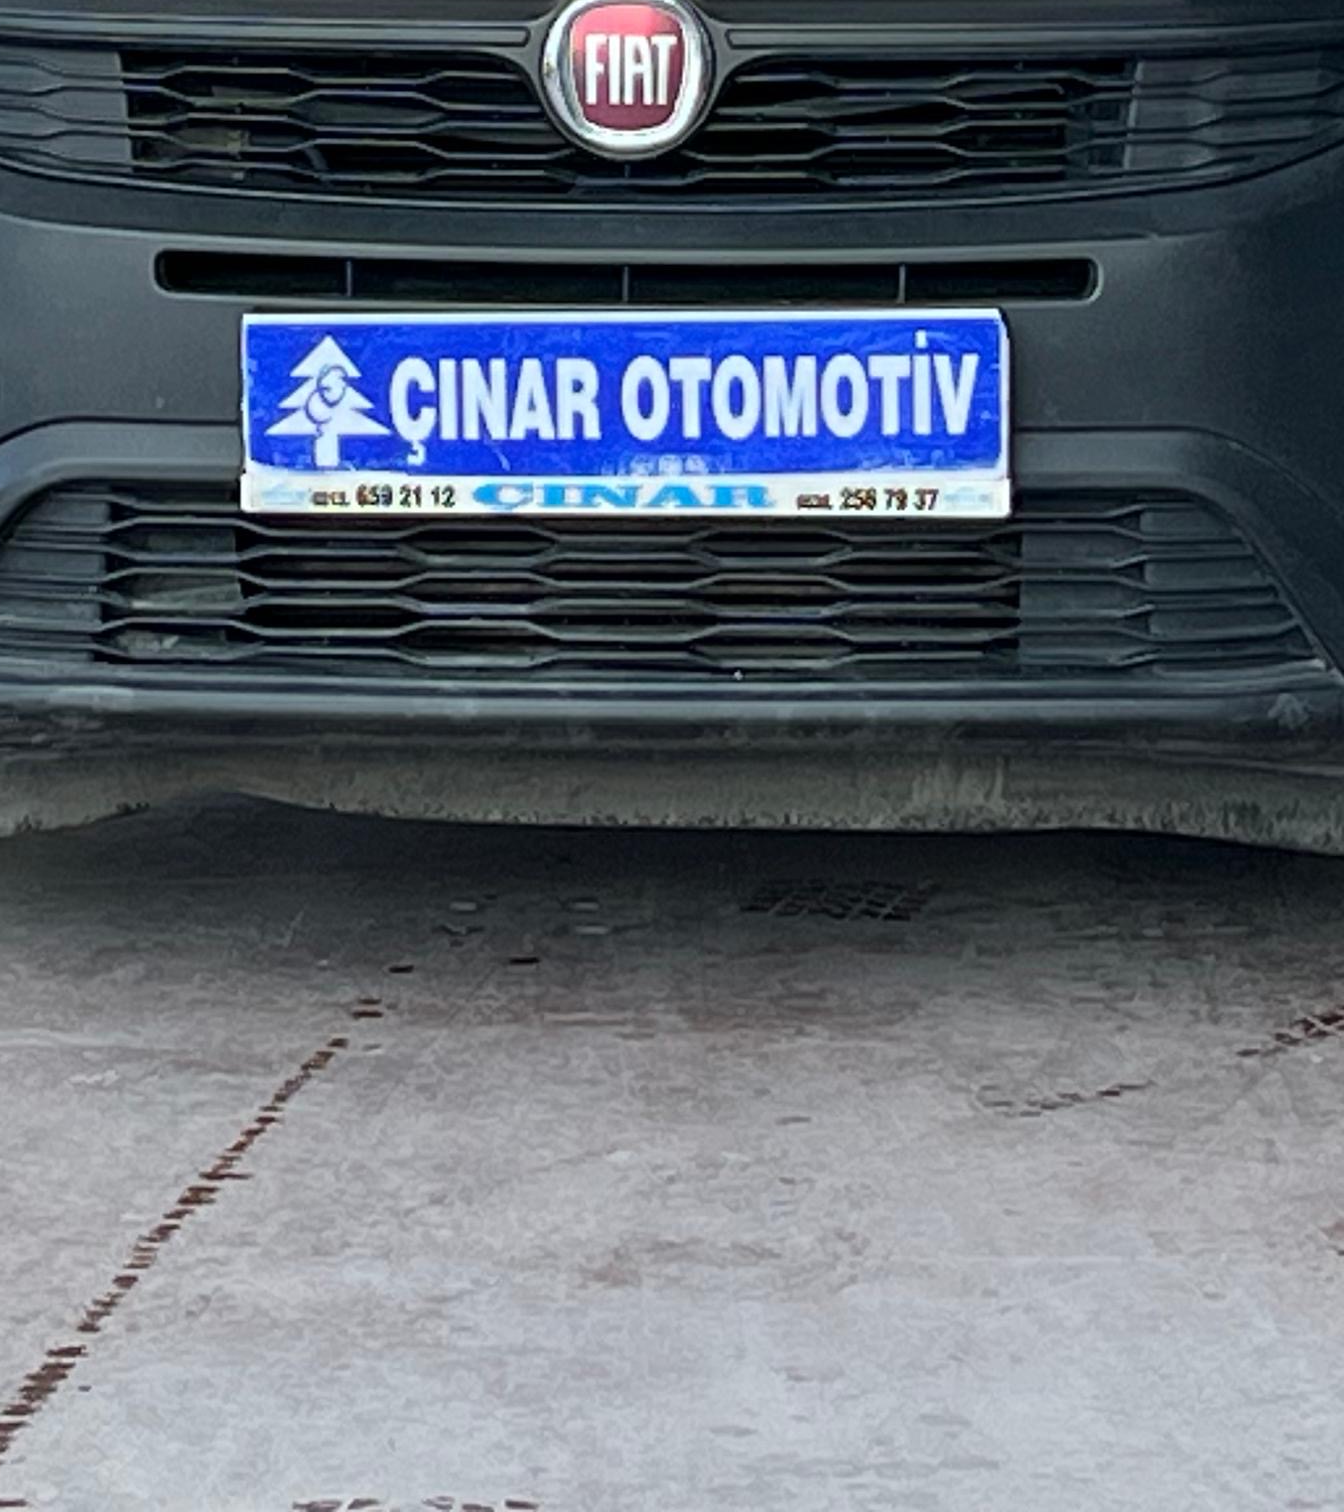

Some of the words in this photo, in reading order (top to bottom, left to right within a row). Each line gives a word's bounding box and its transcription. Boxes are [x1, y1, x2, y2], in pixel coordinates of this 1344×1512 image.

[584, 32, 679, 106] FIAT
[389, 356, 602, 466] ÇINAR
[621, 329, 980, 441] OTOMOTİV
[399, 484, 422, 508] 21
[431, 485, 456, 508] 12
